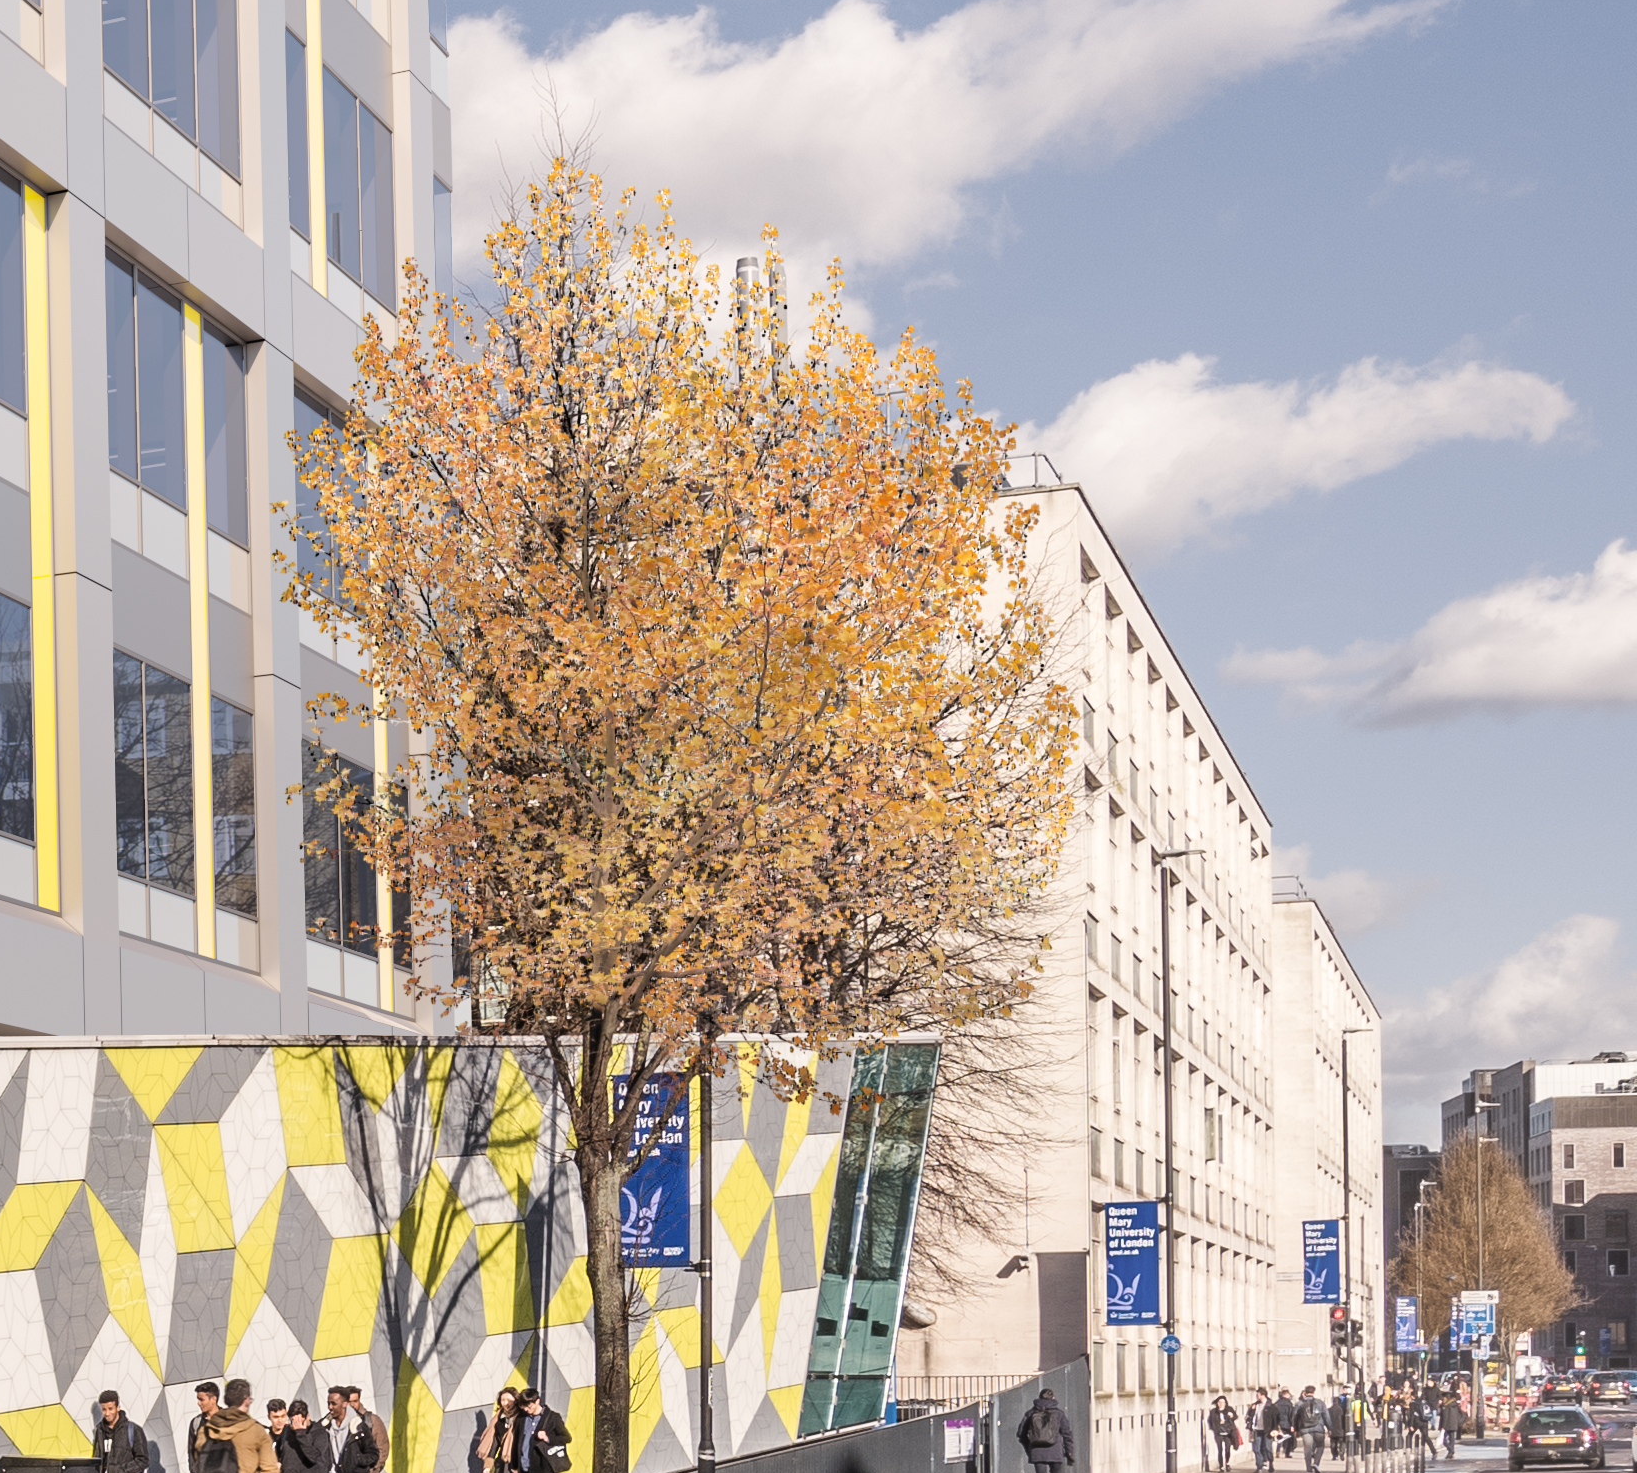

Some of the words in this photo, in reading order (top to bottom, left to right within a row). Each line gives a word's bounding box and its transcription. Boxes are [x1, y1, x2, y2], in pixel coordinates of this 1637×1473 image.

[618, 1082, 659, 1096] Qen
[1108, 1207, 1137, 1216] Queen
[1108, 1217, 1132, 1228] Mary
[1108, 1226, 1156, 1238] University
[1109, 1239, 1119, 1248] of
[1121, 1238, 1154, 1247] London
